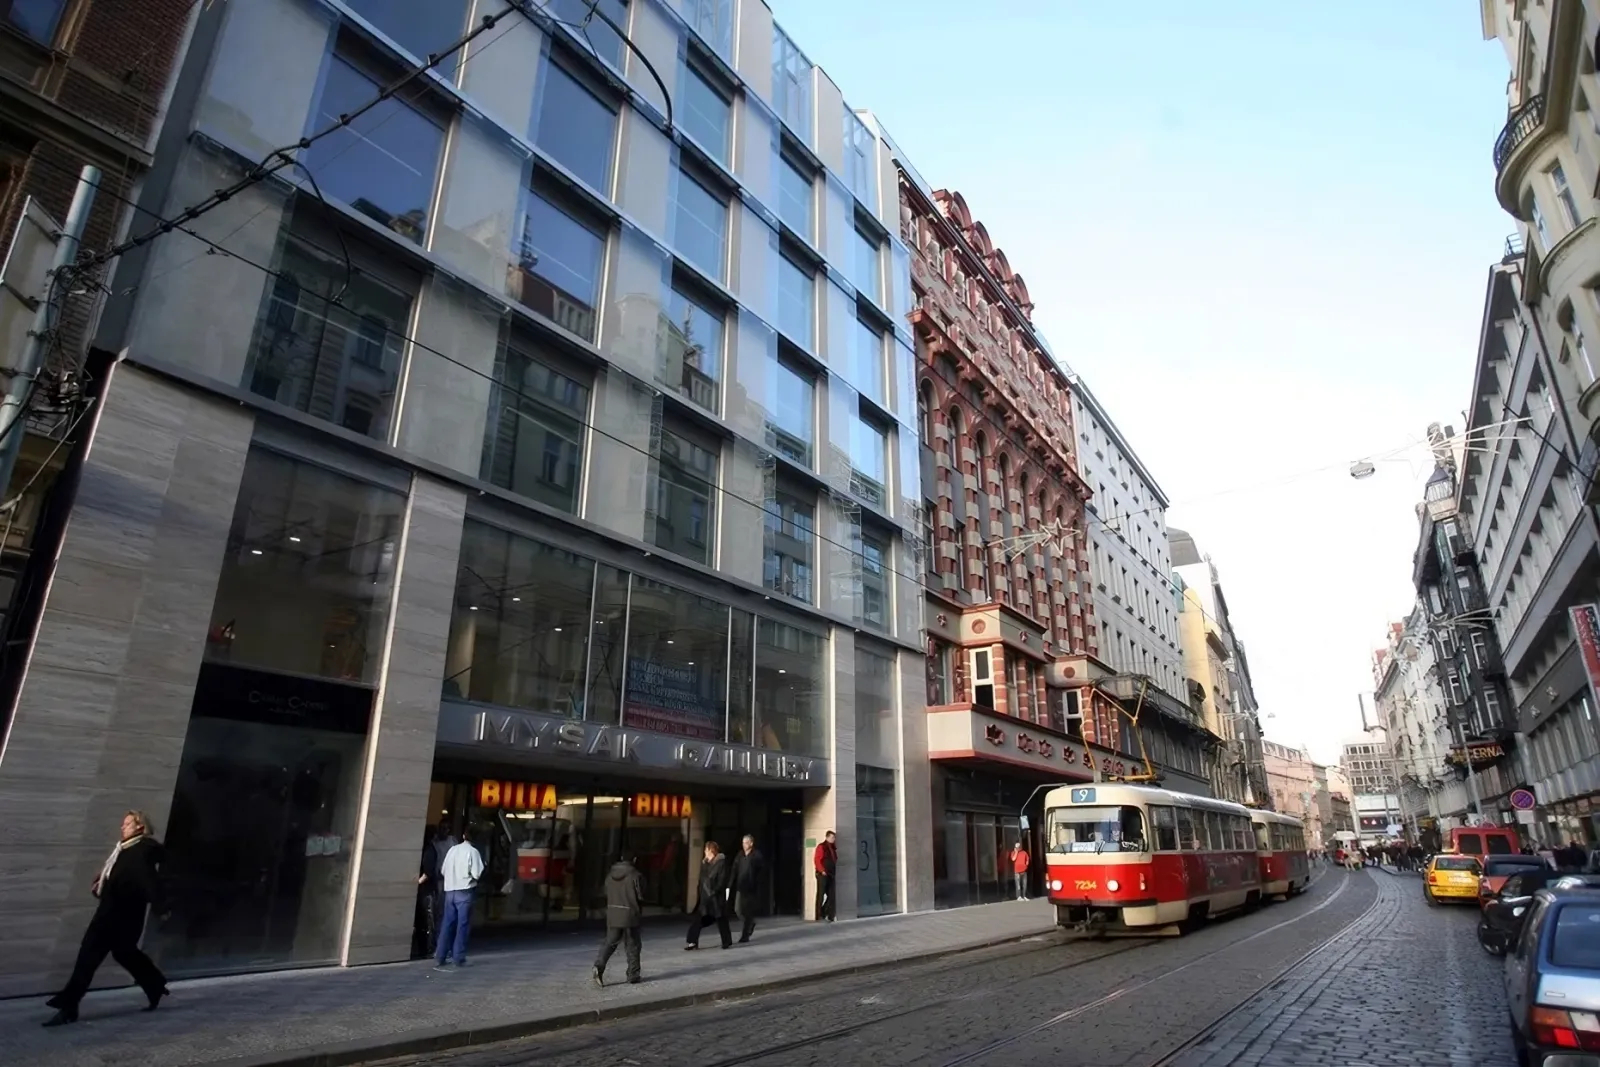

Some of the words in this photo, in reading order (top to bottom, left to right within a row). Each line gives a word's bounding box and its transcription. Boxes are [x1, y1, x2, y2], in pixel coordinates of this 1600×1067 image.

[674, 742, 814, 780] GALLERY
[480, 779, 557, 810] BILLA
[636, 793, 693, 819] BILLA
[1079, 789, 1089, 801] 9
[1074, 880, 1097, 890] 7234
